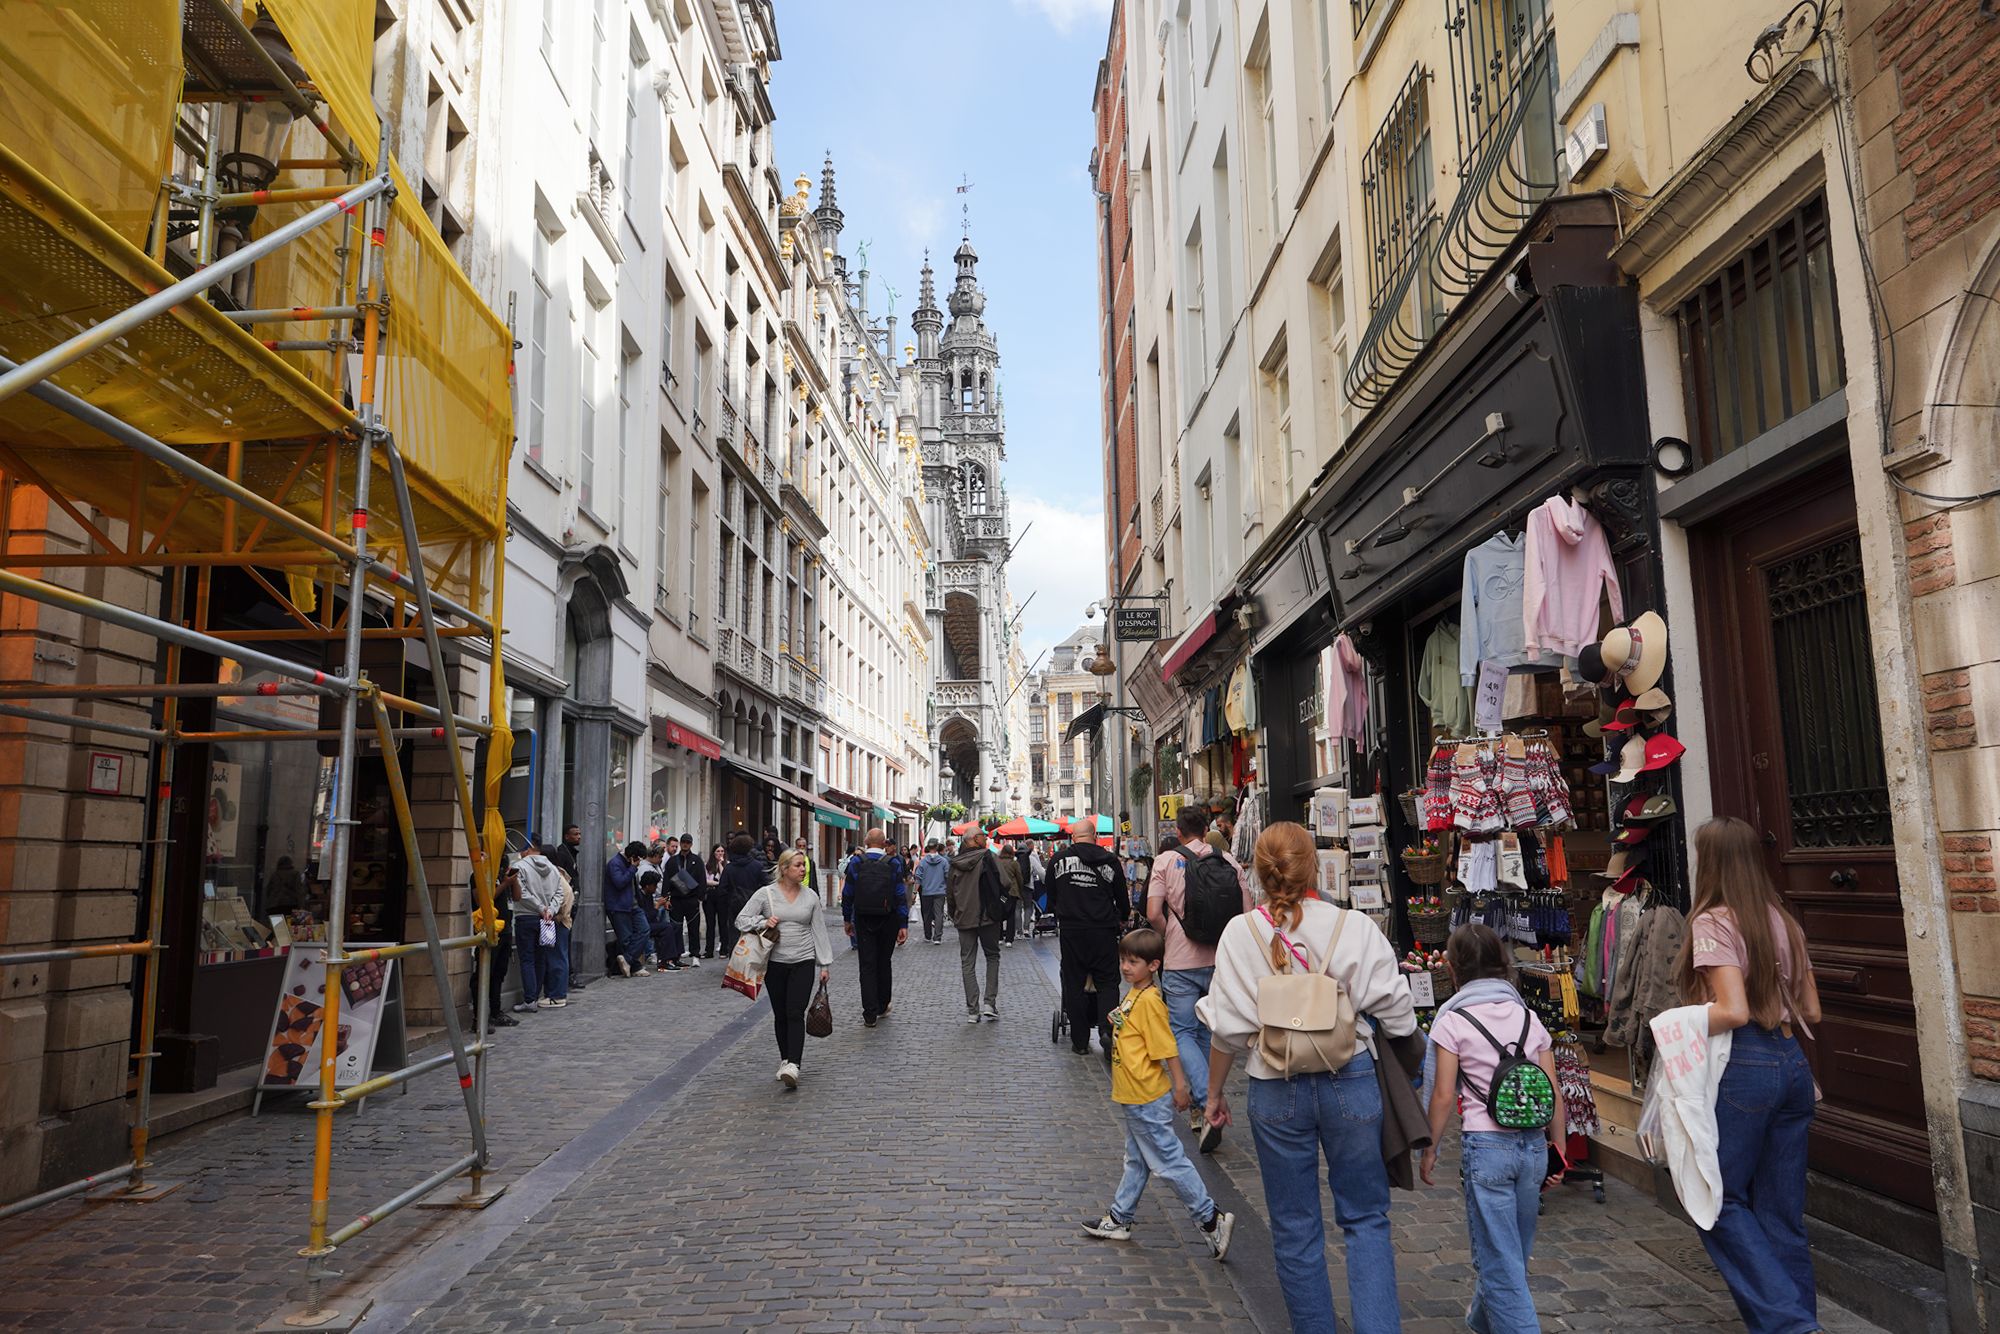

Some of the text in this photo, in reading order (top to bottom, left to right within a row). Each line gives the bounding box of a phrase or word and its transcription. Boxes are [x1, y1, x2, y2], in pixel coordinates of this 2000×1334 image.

[1136, 611, 1152, 619] ROY
[1118, 619, 1157, 627] D'ESPAGNE
[1162, 801, 1171, 819] 2
[1655, 1021, 1684, 1048] PA
